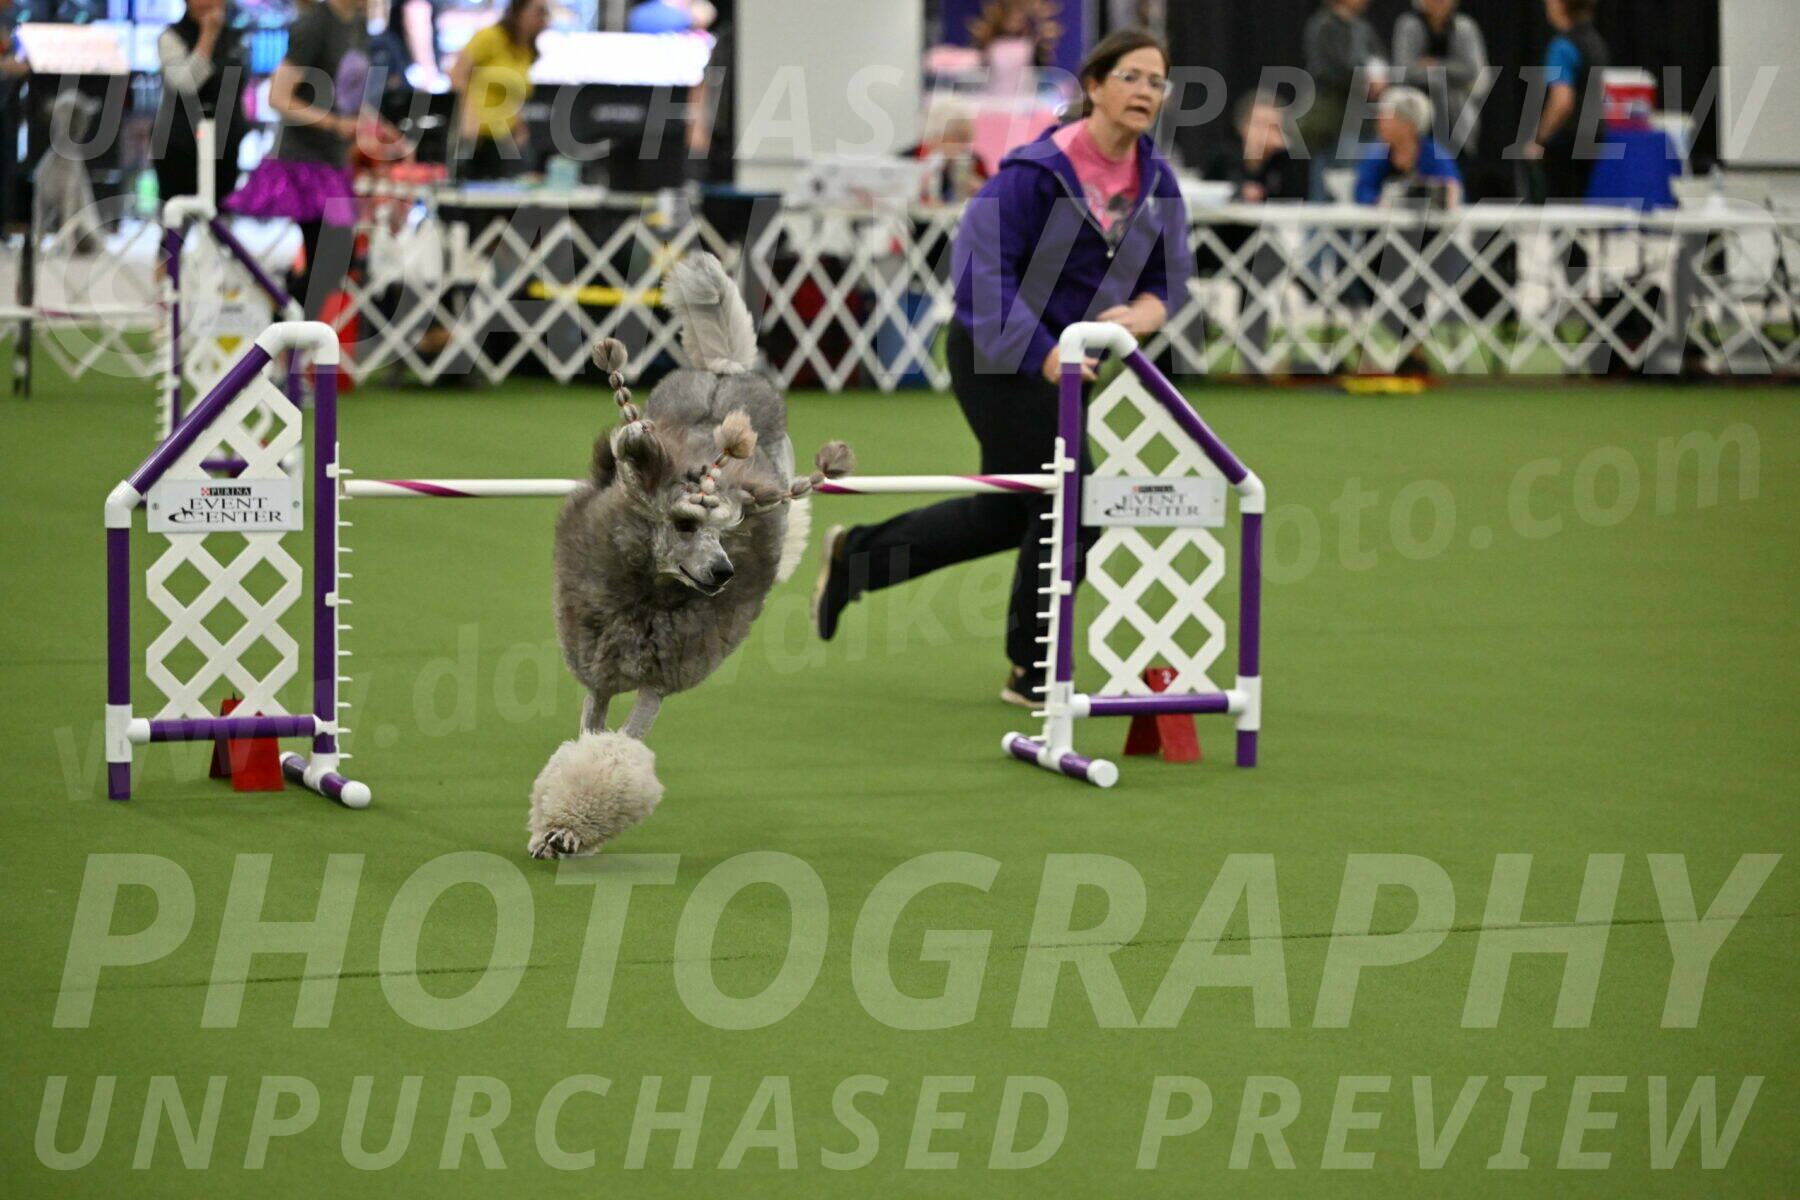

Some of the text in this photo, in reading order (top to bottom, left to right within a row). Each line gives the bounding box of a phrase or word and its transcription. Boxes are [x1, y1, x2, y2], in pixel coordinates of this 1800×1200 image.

[210, 487, 252, 496] PURINA
[190, 498, 268, 510] EVENT
[168, 509, 283, 524] CENTER
